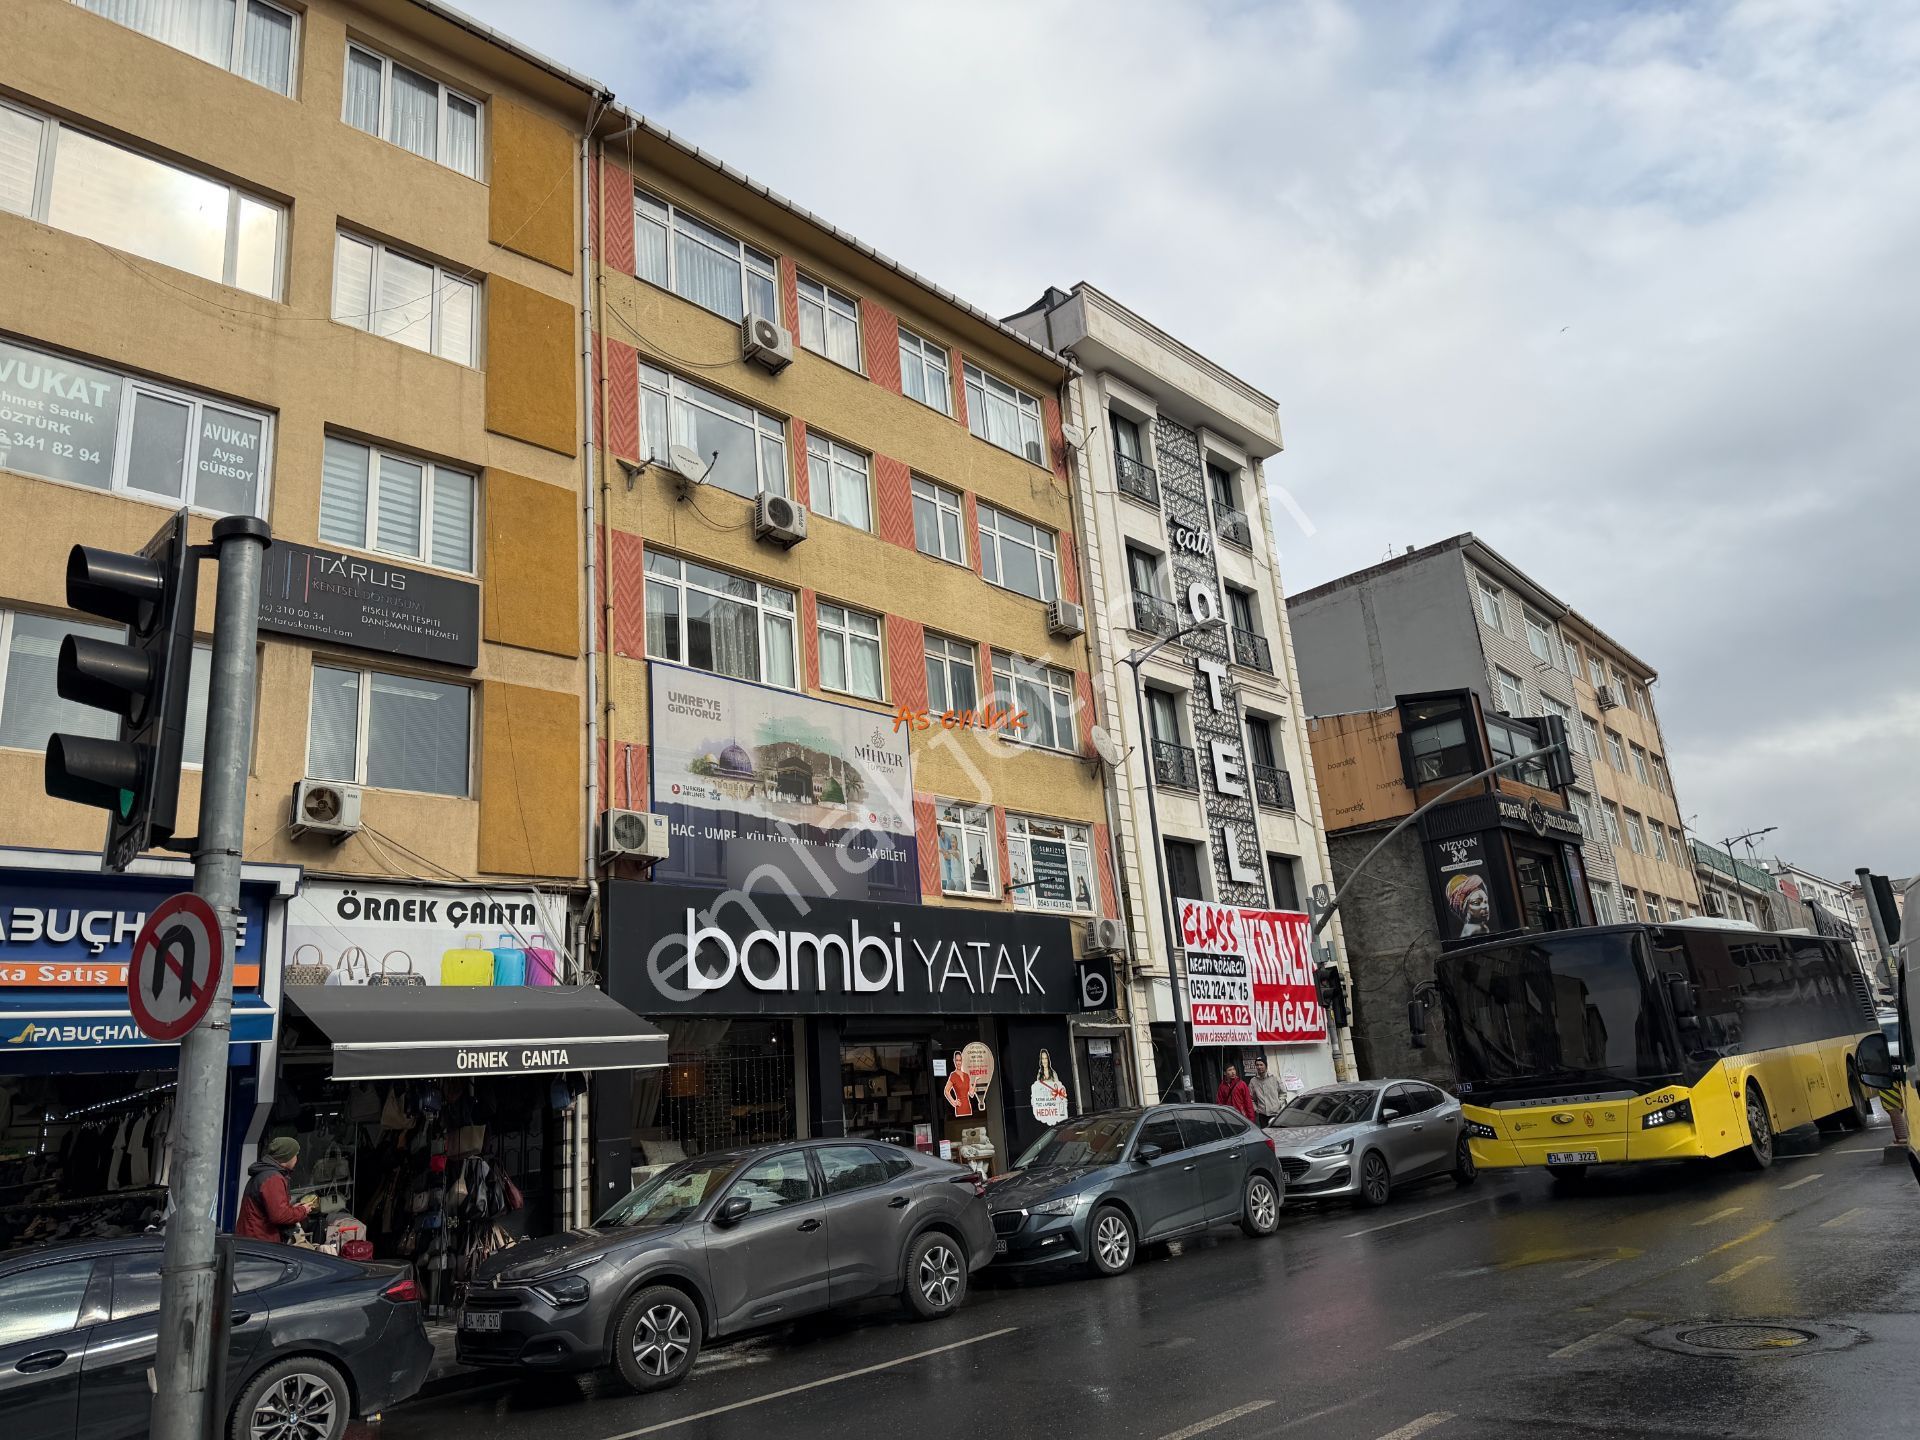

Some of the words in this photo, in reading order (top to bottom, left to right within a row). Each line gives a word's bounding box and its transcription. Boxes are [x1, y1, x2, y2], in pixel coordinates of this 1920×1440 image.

[0, 406, 72, 436] ÖZTÜRK
[49, 404, 95, 424] Sadık
[203, 422, 258, 450] AVUKAT
[13, 432, 45, 451] 341
[52, 442, 74, 458] 82
[79, 448, 101, 465] 94
[212, 447, 244, 464] Ayşe
[199, 460, 254, 482] GÜRSOY
[314, 554, 406, 591] TARUS
[276, 604, 295, 616] 310
[297, 609, 310, 618] 00
[312, 612, 324, 622] 34
[390, 610, 410, 621] YAPI
[667, 690, 721, 712] UMRE'YE
[1187, 582, 1258, 885] OTEL
[854, 744, 904, 768] MİHVER
[670, 823, 696, 837] HAC
[880, 847, 907, 863] BİLETİ
[336, 889, 438, 924] ÖRNEK
[446, 899, 536, 929] ÇANTA
[1182, 903, 1239, 953] CLASS
[687, 907, 905, 992] bambi
[912, 939, 1046, 995] YATAK
[38, 965, 109, 984] Satış
[1191, 980, 1211, 1000] 0532
[1212, 981, 1227, 1000] 224
[1239, 983, 1249, 1001] 15
[1196, 1005, 1218, 1024] 444
[1220, 1006, 1233, 1024] 13
[1234, 1006, 1249, 1024] 02
[456, 1049, 509, 1069] ÖRNEK
[521, 1049, 569, 1069] ÇANTA
[1644, 1093, 1675, 1106] C-489
